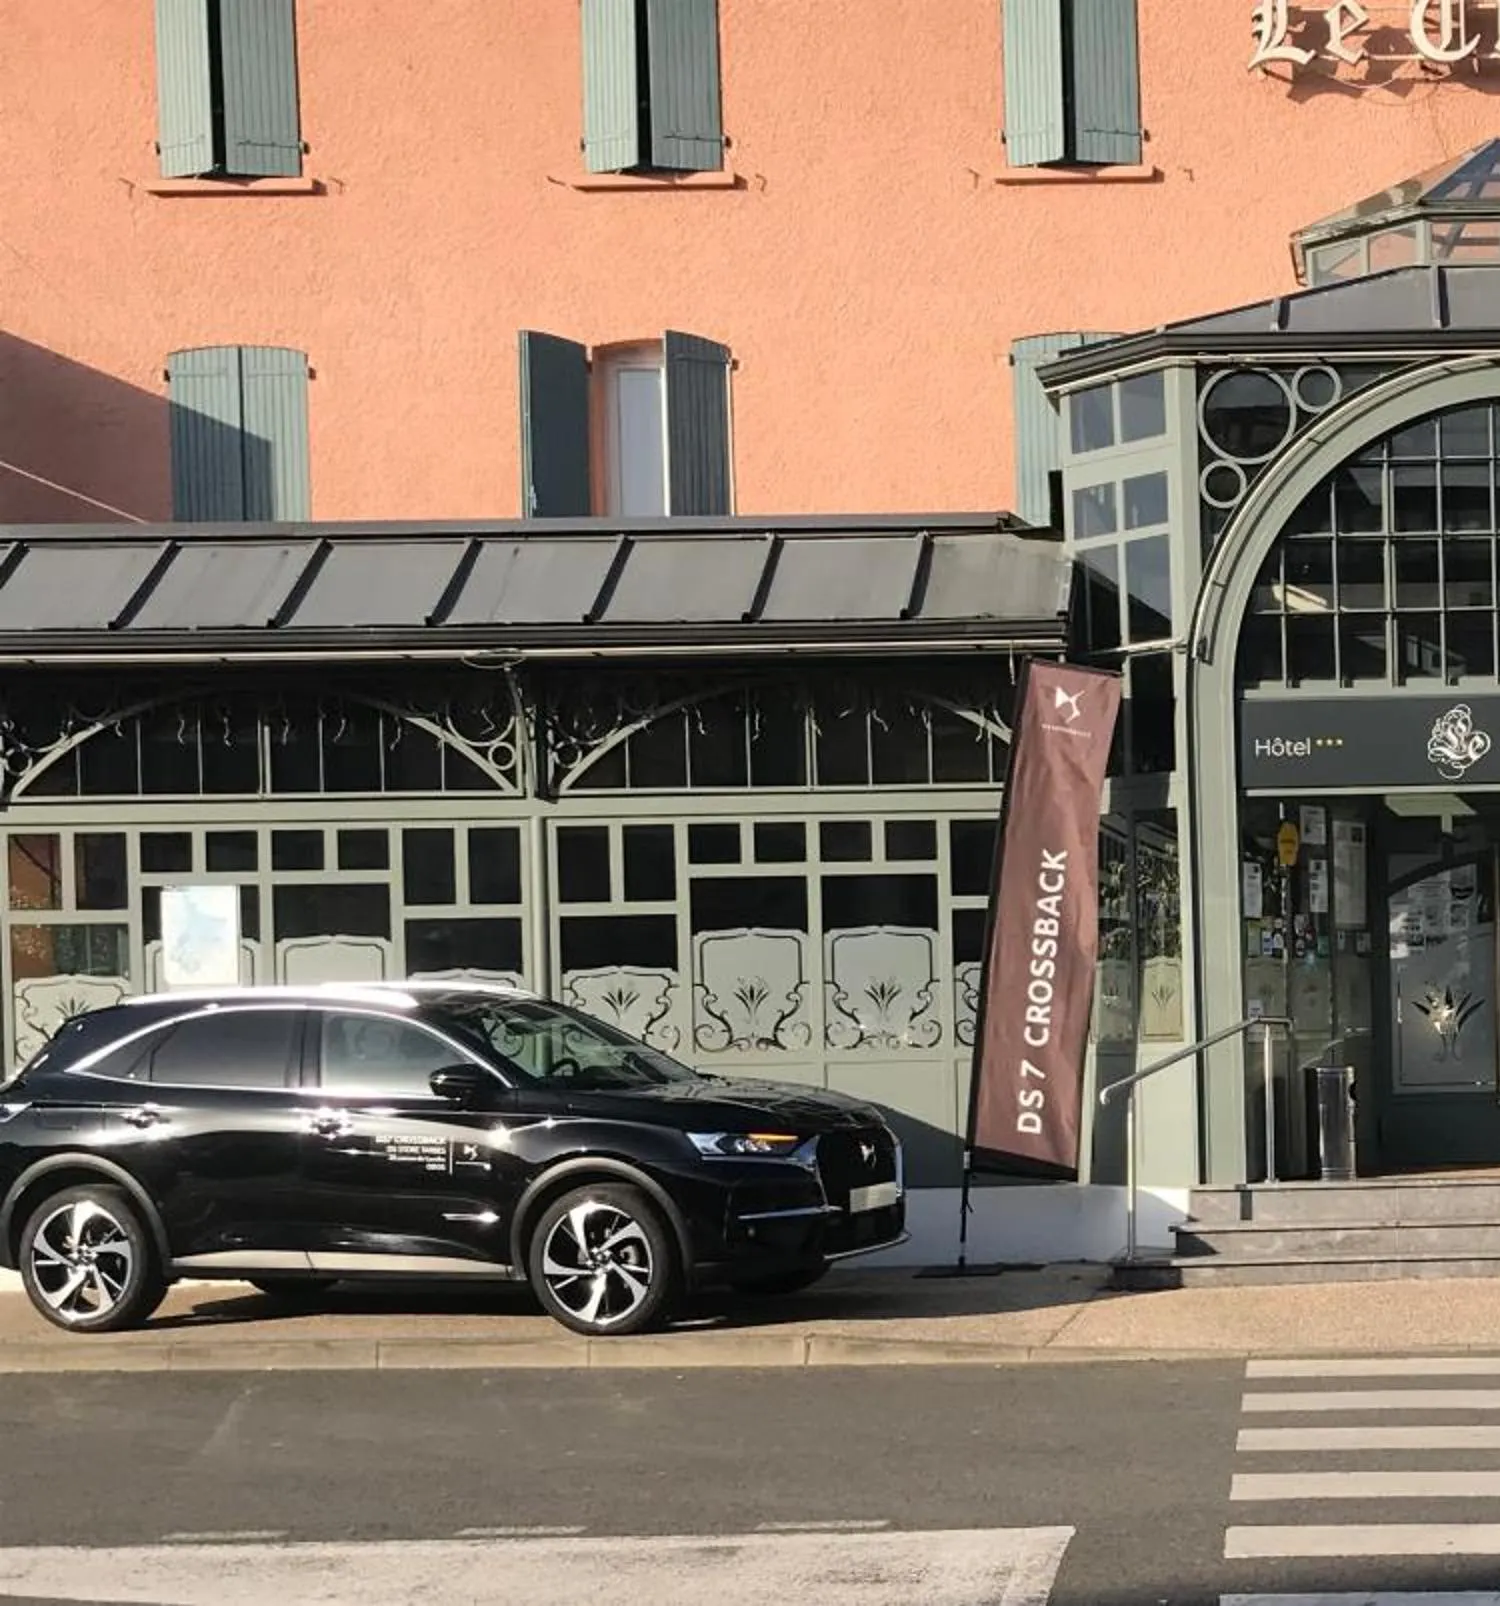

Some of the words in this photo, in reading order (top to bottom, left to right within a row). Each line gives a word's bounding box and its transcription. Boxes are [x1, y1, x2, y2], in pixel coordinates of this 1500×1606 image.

[1248, 0, 1370, 69] Le
[1255, 736, 1311, 757] Hôtel
[1426, 703, 1492, 780] Le
[1023, 848, 1069, 1046] CROSSBACK
[1020, 1059, 1045, 1079] 7
[1017, 1089, 1044, 1134] DS
